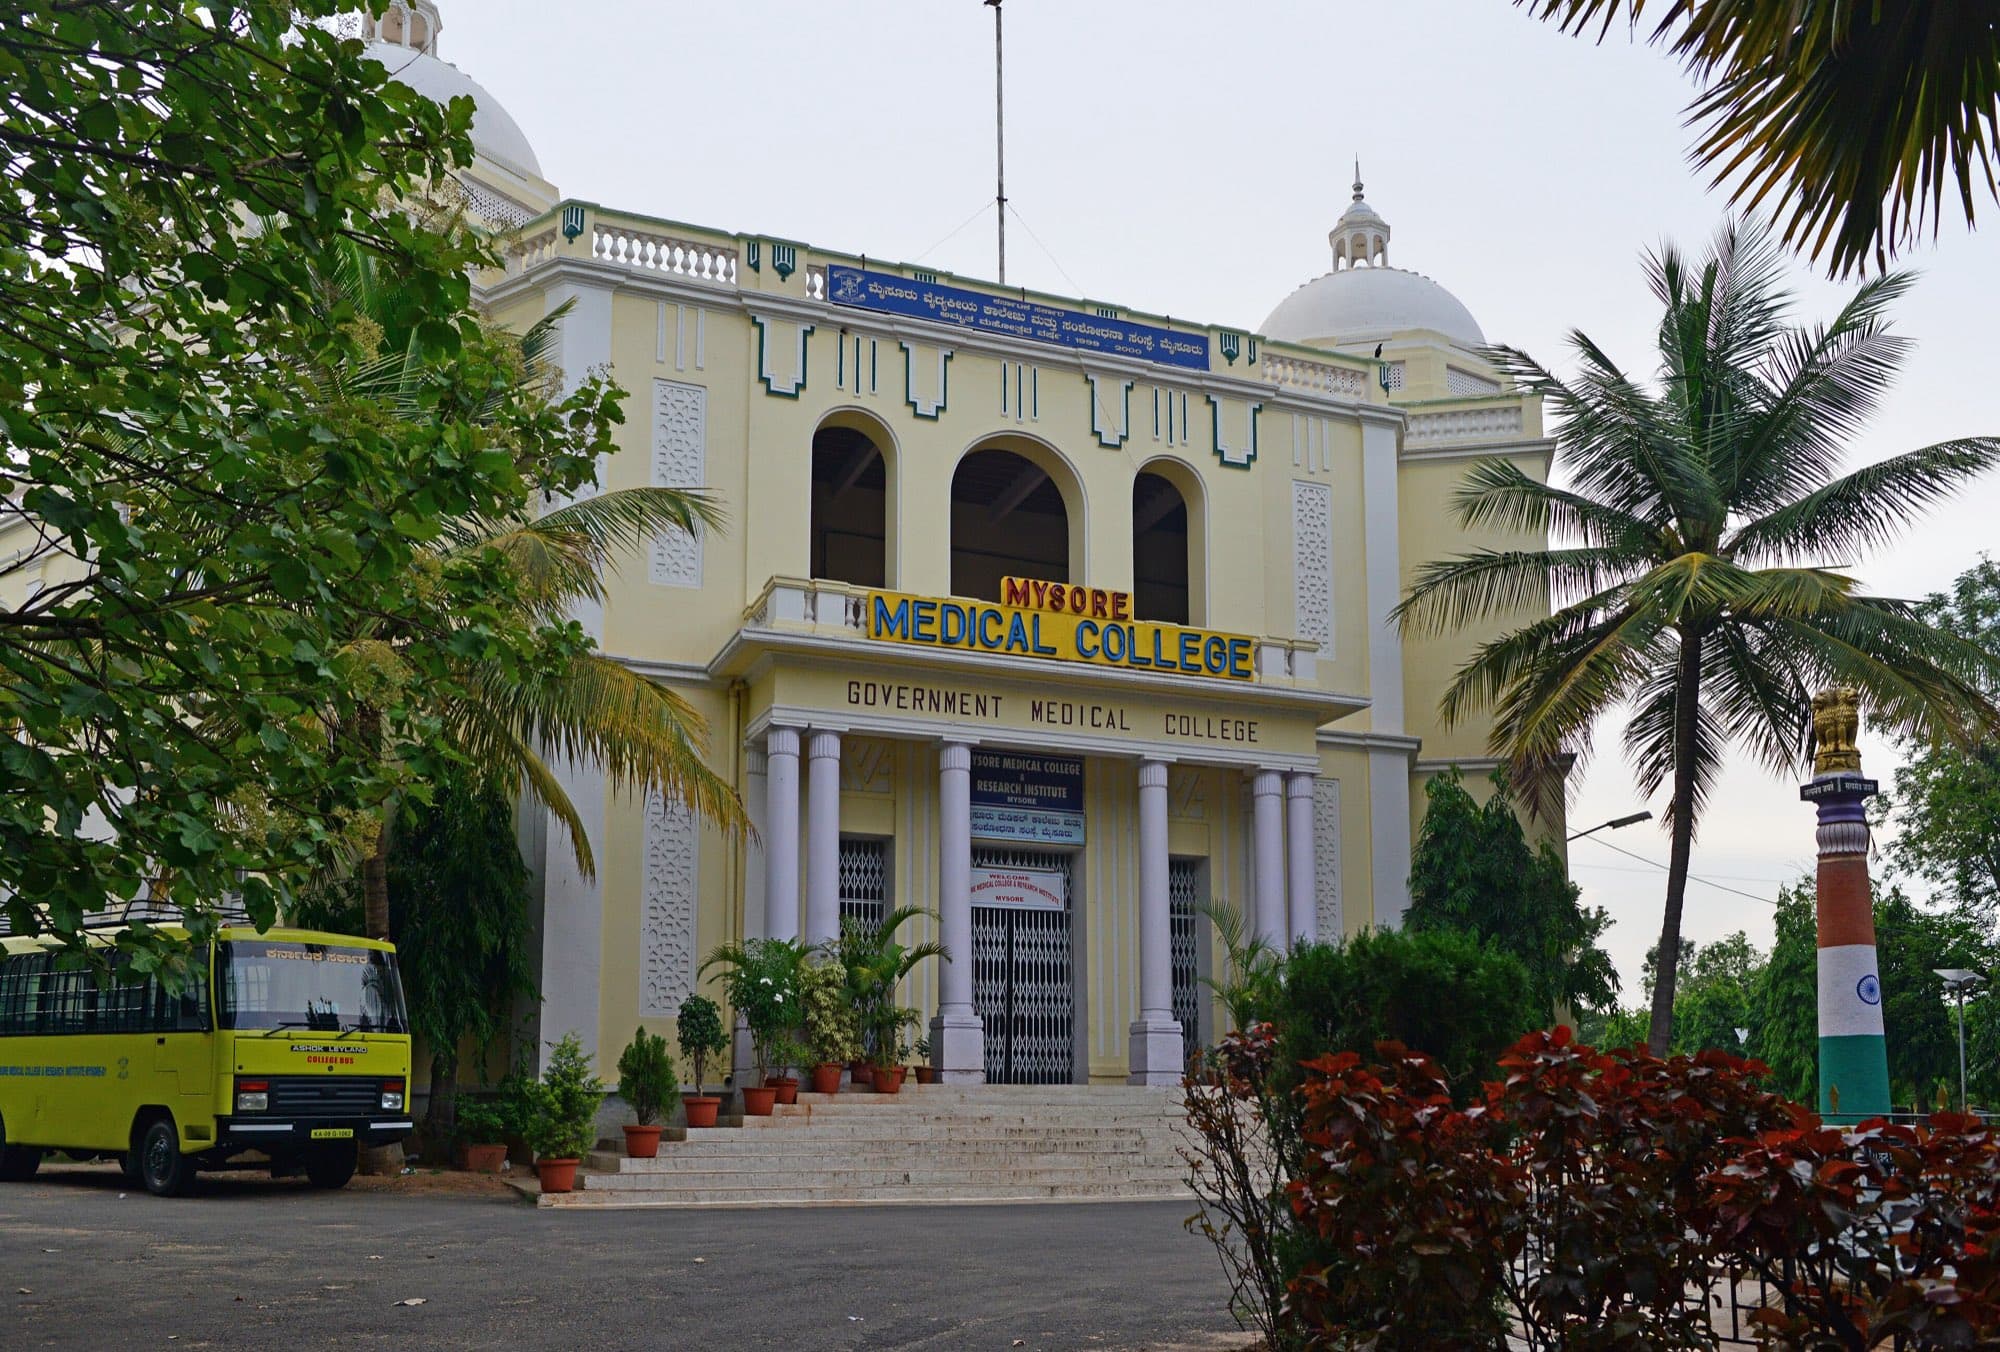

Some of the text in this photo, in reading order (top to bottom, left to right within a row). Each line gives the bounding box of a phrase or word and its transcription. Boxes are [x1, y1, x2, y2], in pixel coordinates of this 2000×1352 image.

[868, 281, 918, 300] ಮೈಸೂರು
[923, 292, 978, 312] ವೈದ್ಯಕೀಯ
[983, 305, 1026, 322] ಕಾಲೇಜು
[1031, 314, 1058, 332] ಮತ್ತು
[1062, 320, 1124, 341] ಸಂಶೋಧನಾ
[1160, 338, 1203, 356] ಮೈಸೂರು
[1006, 577, 1129, 620] MYSORE
[874, 595, 1252, 678] MEDICAL COLLEGE
[848, 681, 1259, 742] GOVERNMENT MEDICAL COLLEGE
[972, 754, 1081, 775] YSORE MEDICAL COLLEGE
[977, 780, 1068, 798] RESEARCH INSTITUTE
[1007, 796, 1037, 805] MYSORE
[307, 1056, 337, 1064] COLLEGE
